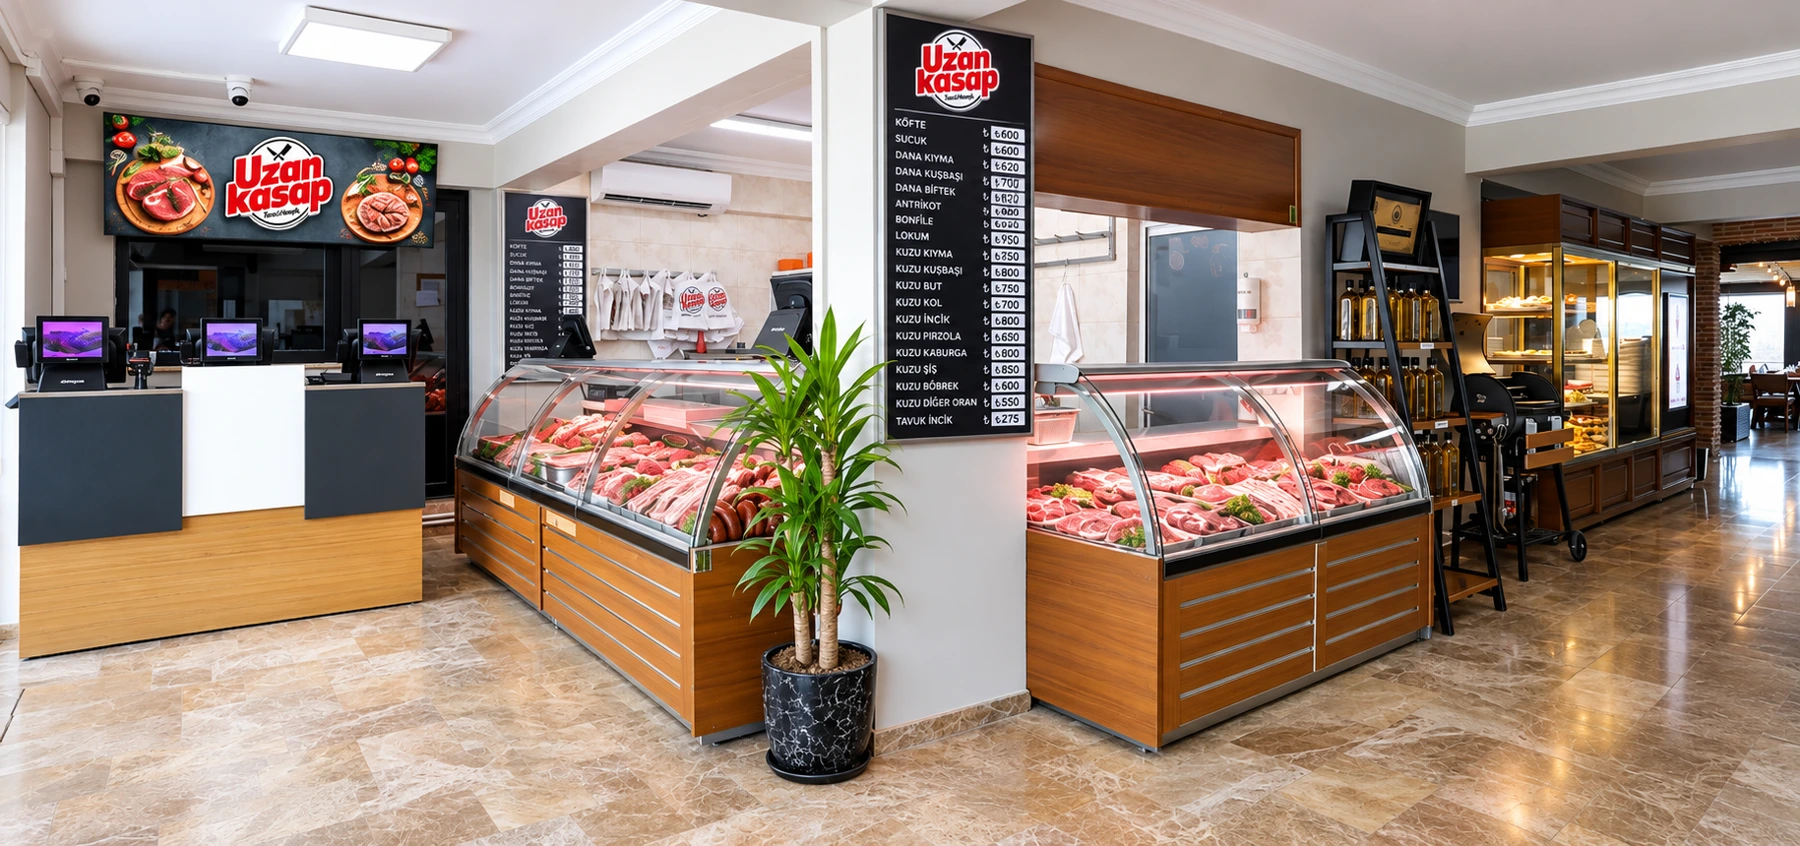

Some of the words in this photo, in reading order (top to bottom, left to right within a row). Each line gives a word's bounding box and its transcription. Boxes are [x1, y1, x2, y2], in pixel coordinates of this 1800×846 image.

[920, 44, 990, 73] Uzan
[916, 69, 998, 98] kasap
[895, 134, 927, 145] SUCUK
[995, 130, 1019, 140] ₺600
[995, 146, 1019, 156] ₺600
[895, 150, 922, 161] DANA
[924, 153, 954, 164] KIYMA
[235, 155, 322, 189] Uzan
[995, 161, 1019, 172] ₺620
[895, 166, 922, 177] DANA
[924, 169, 963, 182] KUŞBAŞI
[995, 178, 1019, 189] ₺700
[895, 183, 922, 193] DANA
[924, 184, 956, 196] BİFTEK
[227, 178, 332, 215] kasap
[895, 199, 941, 210] ANTRİKOT
[528, 207, 562, 221] Uzan
[895, 214, 933, 225] BONFİLE
[525, 216, 567, 231] kasap
[895, 231, 929, 240] LOKUM
[895, 248, 921, 257] KUZU
[924, 249, 953, 259] KIYMA
[895, 265, 921, 274] KUZU
[924, 265, 963, 276] KUŞBAŞI
[995, 267, 1019, 277] ₺800
[895, 281, 921, 290] KUZU
[924, 281, 942, 291] BUT
[995, 284, 1019, 293] ₺750
[895, 298, 921, 307] KUZU
[924, 299, 942, 308] KOL
[995, 300, 1019, 309] ₺700
[895, 315, 921, 324] KUZU
[924, 313, 950, 324] İNCİK
[995, 317, 1019, 326] ₺800
[895, 332, 921, 341] KUZU
[924, 332, 961, 341] PIRZOLA
[995, 333, 1019, 342] ₺650
[895, 349, 921, 357] KUZU
[924, 348, 967, 358] KABURGA
[995, 349, 1019, 359] ₺800
[895, 366, 921, 374] KUZU
[923, 363, 937, 375] ŞİŞ
[995, 365, 1019, 375] ₺850
[895, 382, 921, 391] KUZU
[995, 381, 1019, 391] ₺600
[895, 399, 921, 408] KUZU
[952, 398, 978, 407] ORAN
[995, 397, 1019, 407] ₺550
[895, 416, 926, 426] TAVUK
[928, 414, 953, 425] İNCİK
[995, 413, 1019, 424] ₺275
